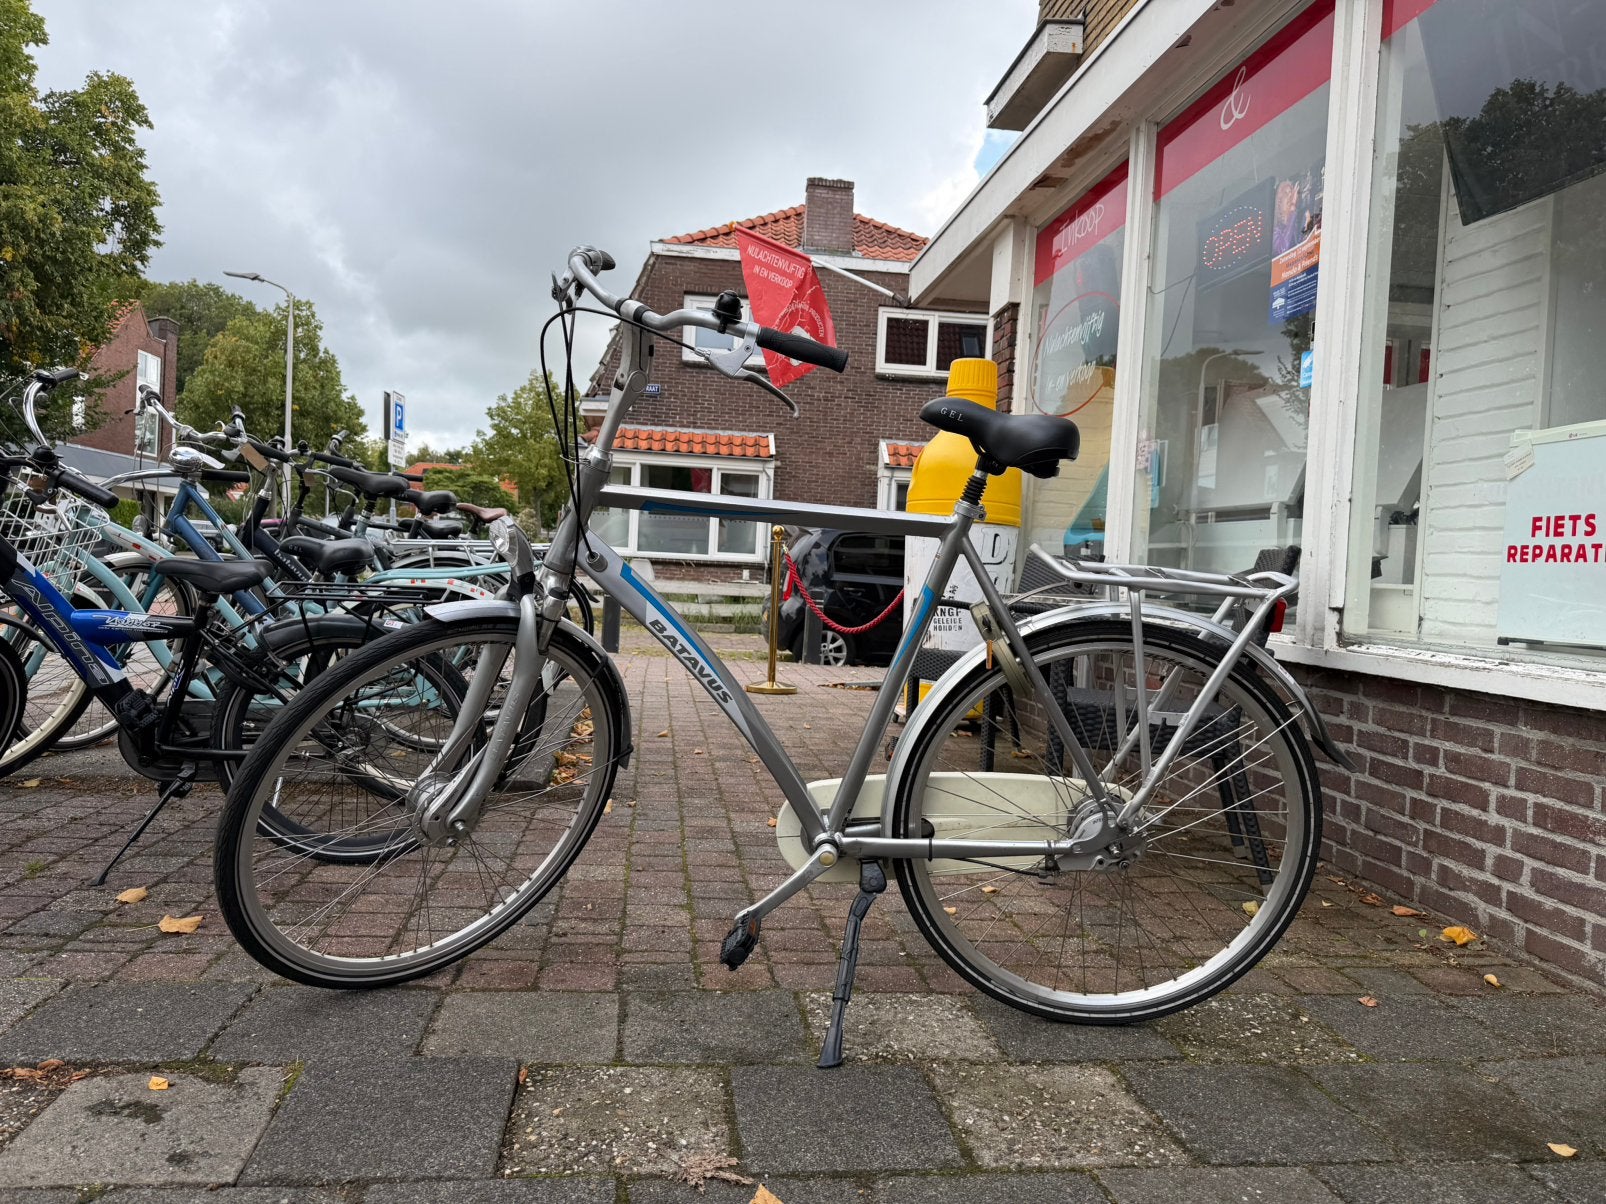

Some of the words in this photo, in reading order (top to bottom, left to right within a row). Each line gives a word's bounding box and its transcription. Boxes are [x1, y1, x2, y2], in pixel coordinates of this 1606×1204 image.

[1220, 66, 1250, 130] &
[1203, 211, 1262, 267] OPEN
[753, 264, 761, 275] IN
[760, 267, 769, 278] EN
[769, 271, 794, 288] VERKOOP
[396, 405, 403, 427] P
[940, 407, 964, 422] GEL
[1531, 513, 1597, 538] FIETS
[1506, 543, 1606, 563] REPARAT
[648, 619, 734, 704] BATAVUS
